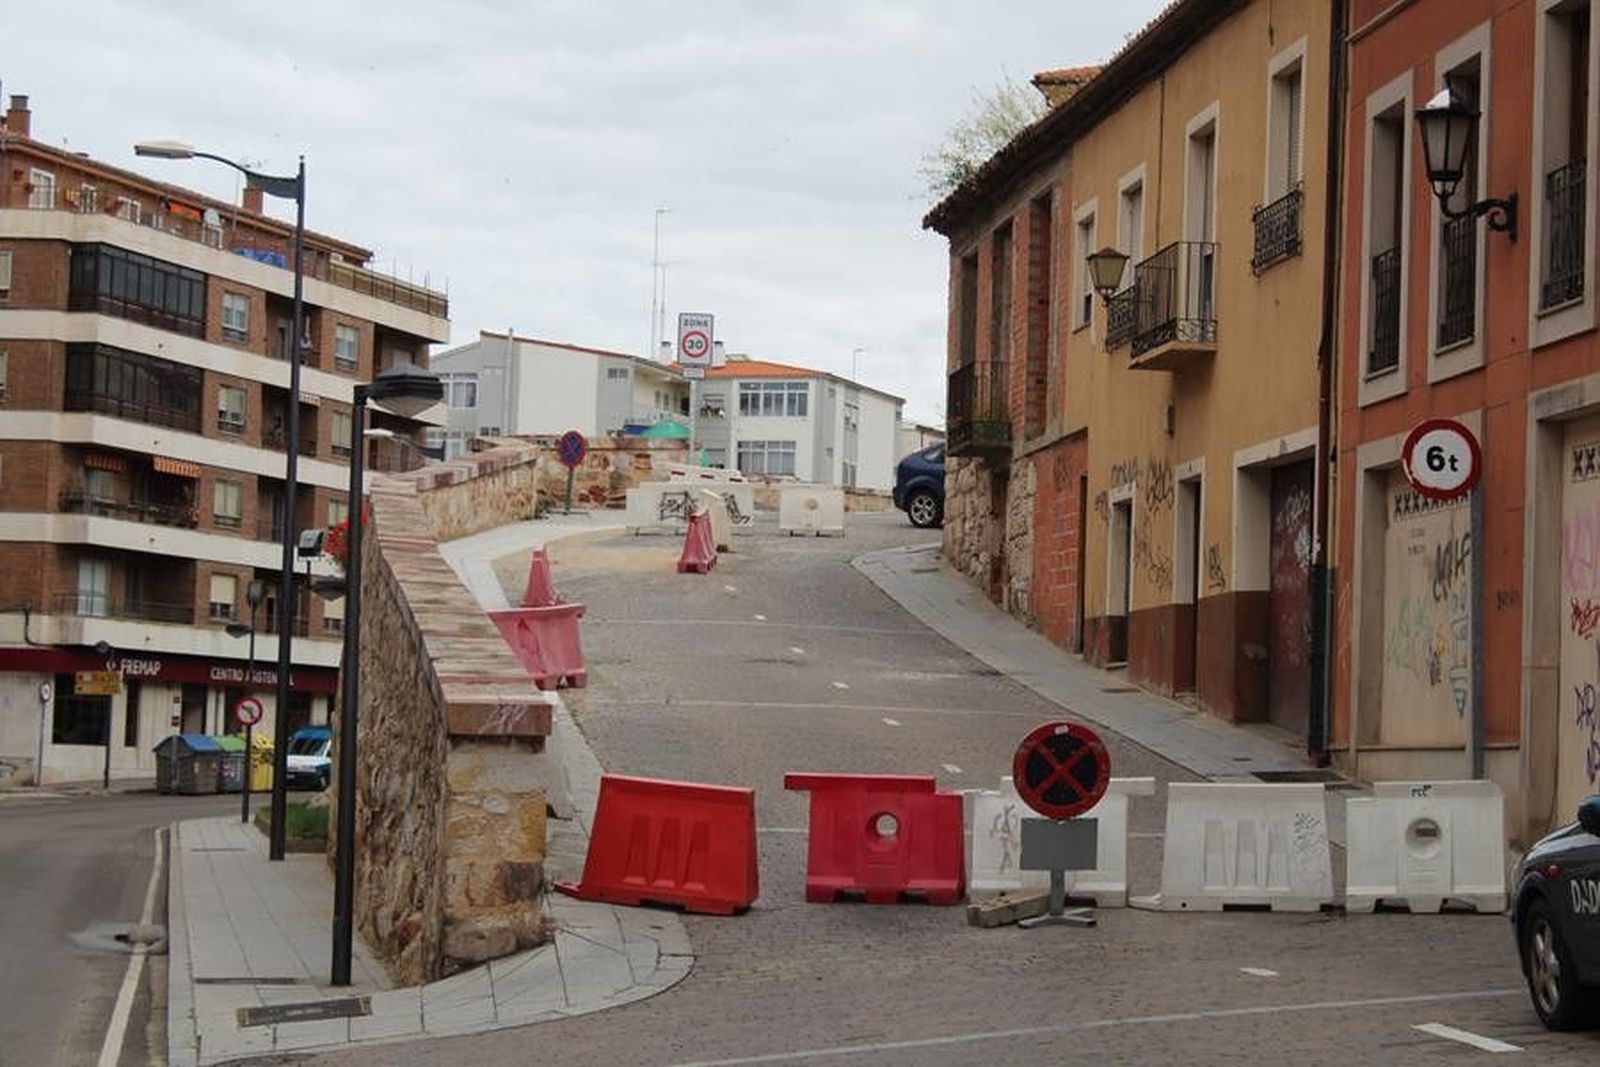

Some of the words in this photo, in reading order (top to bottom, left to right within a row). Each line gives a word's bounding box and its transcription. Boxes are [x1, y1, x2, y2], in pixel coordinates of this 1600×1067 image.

[687, 339, 703, 350] 30
[121, 659, 161, 676] FREMAP
[210, 667, 244, 681] CENTRO
